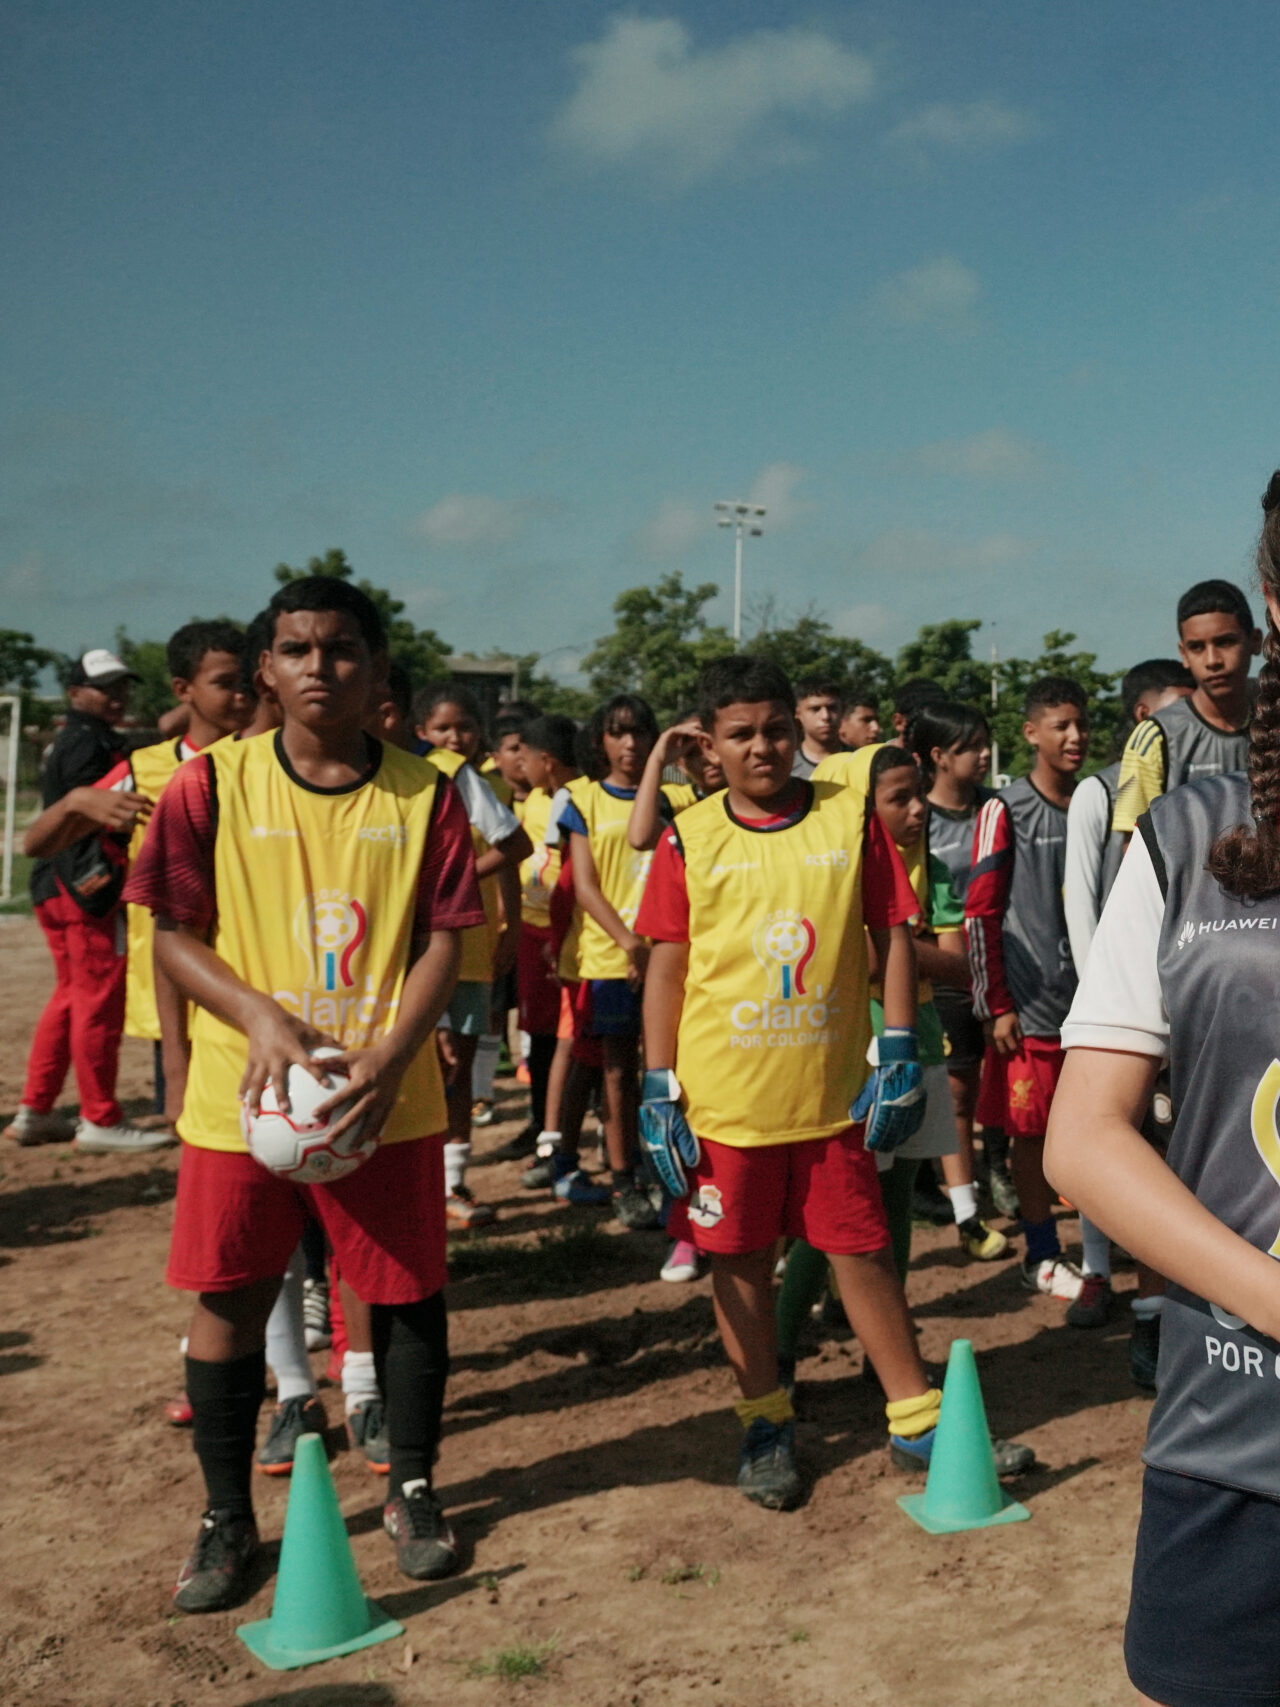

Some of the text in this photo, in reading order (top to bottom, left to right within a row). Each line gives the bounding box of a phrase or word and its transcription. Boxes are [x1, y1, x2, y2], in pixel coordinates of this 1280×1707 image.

[805, 849, 849, 868] FCC15
[1199, 917, 1278, 935] HUAWEI
[731, 1000, 828, 1031] Claro
[731, 1035, 763, 1049] POR
[1205, 1335, 1264, 1378] POR
